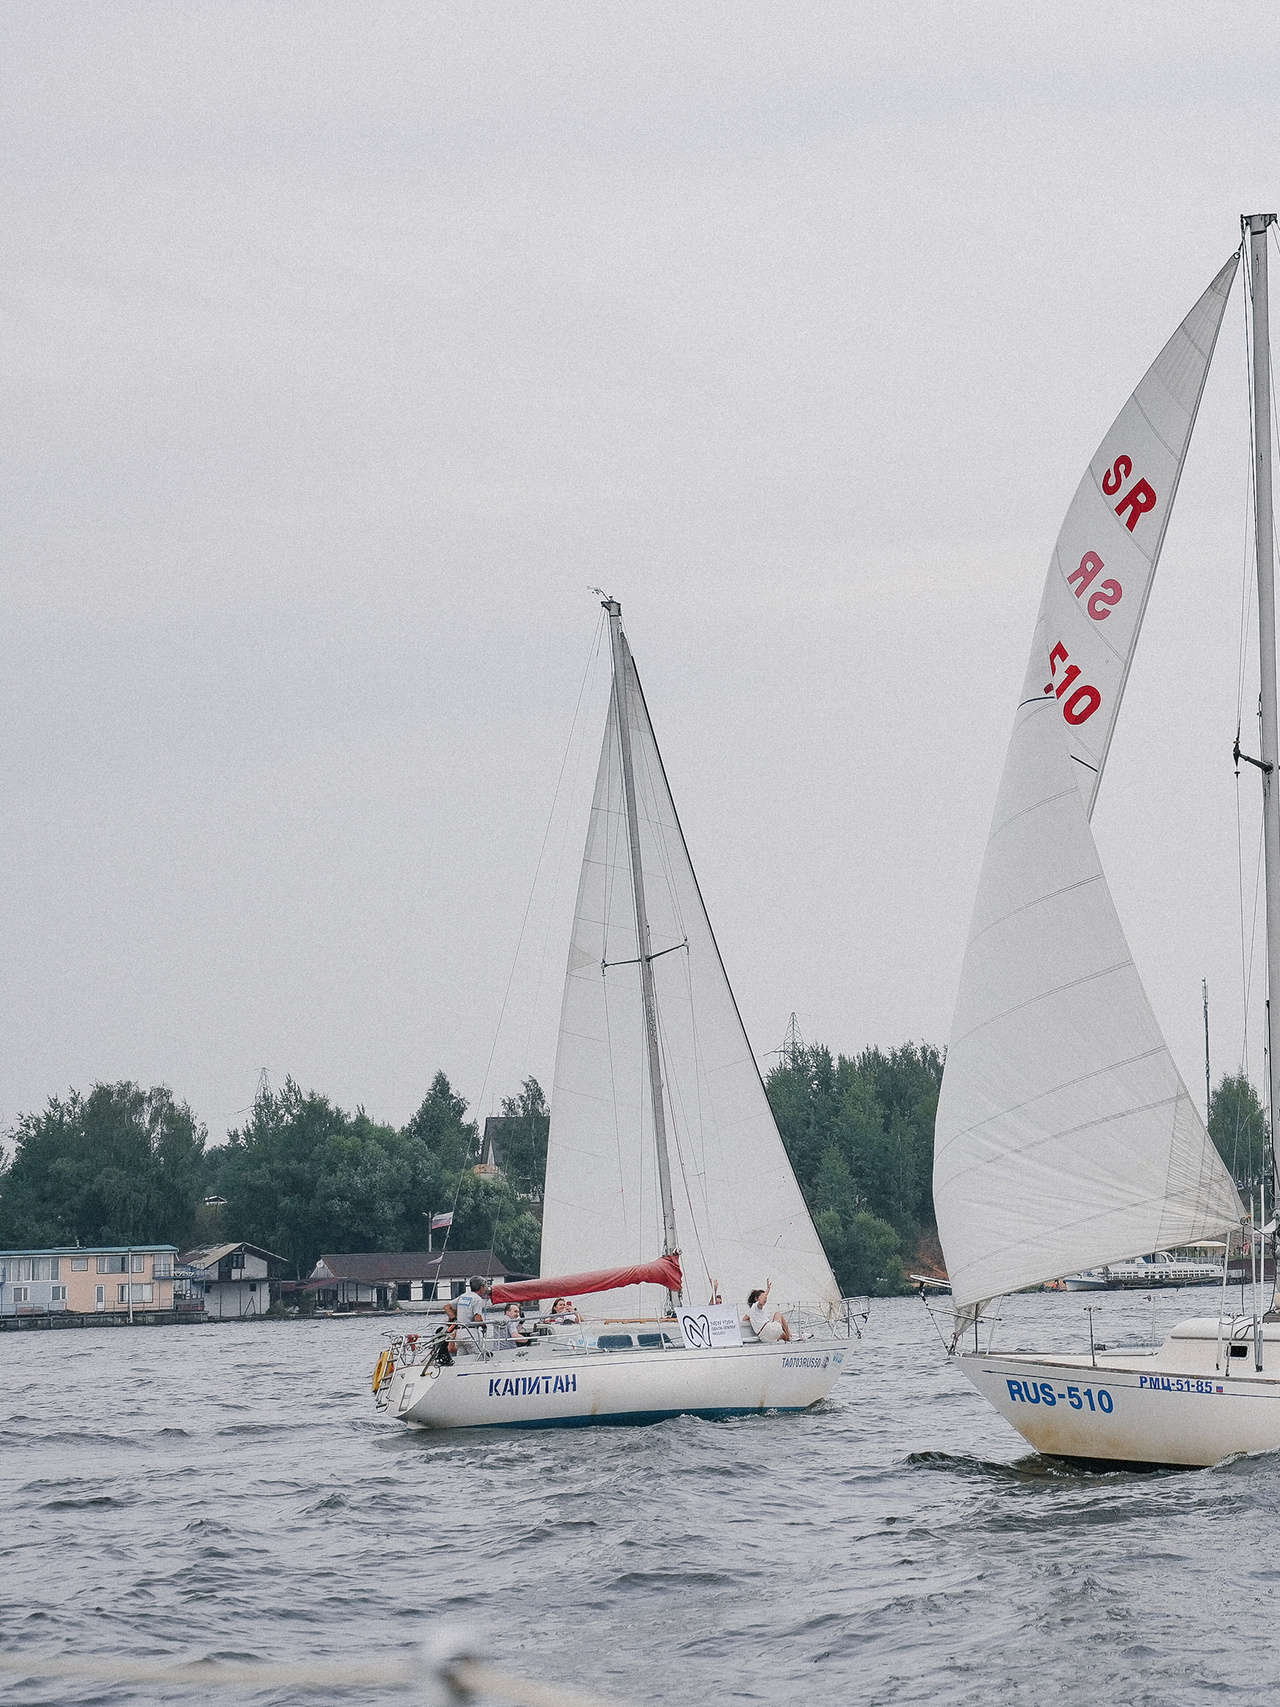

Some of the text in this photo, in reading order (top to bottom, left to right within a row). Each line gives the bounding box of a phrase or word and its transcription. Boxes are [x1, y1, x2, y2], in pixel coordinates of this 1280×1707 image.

[1101, 454, 1157, 533] SR
[488, 1373, 577, 1397] КАПИТАН
[1006, 1379, 1114, 1414] RUS-510
[1139, 1375, 1213, 1393] РМЦ-51-85
